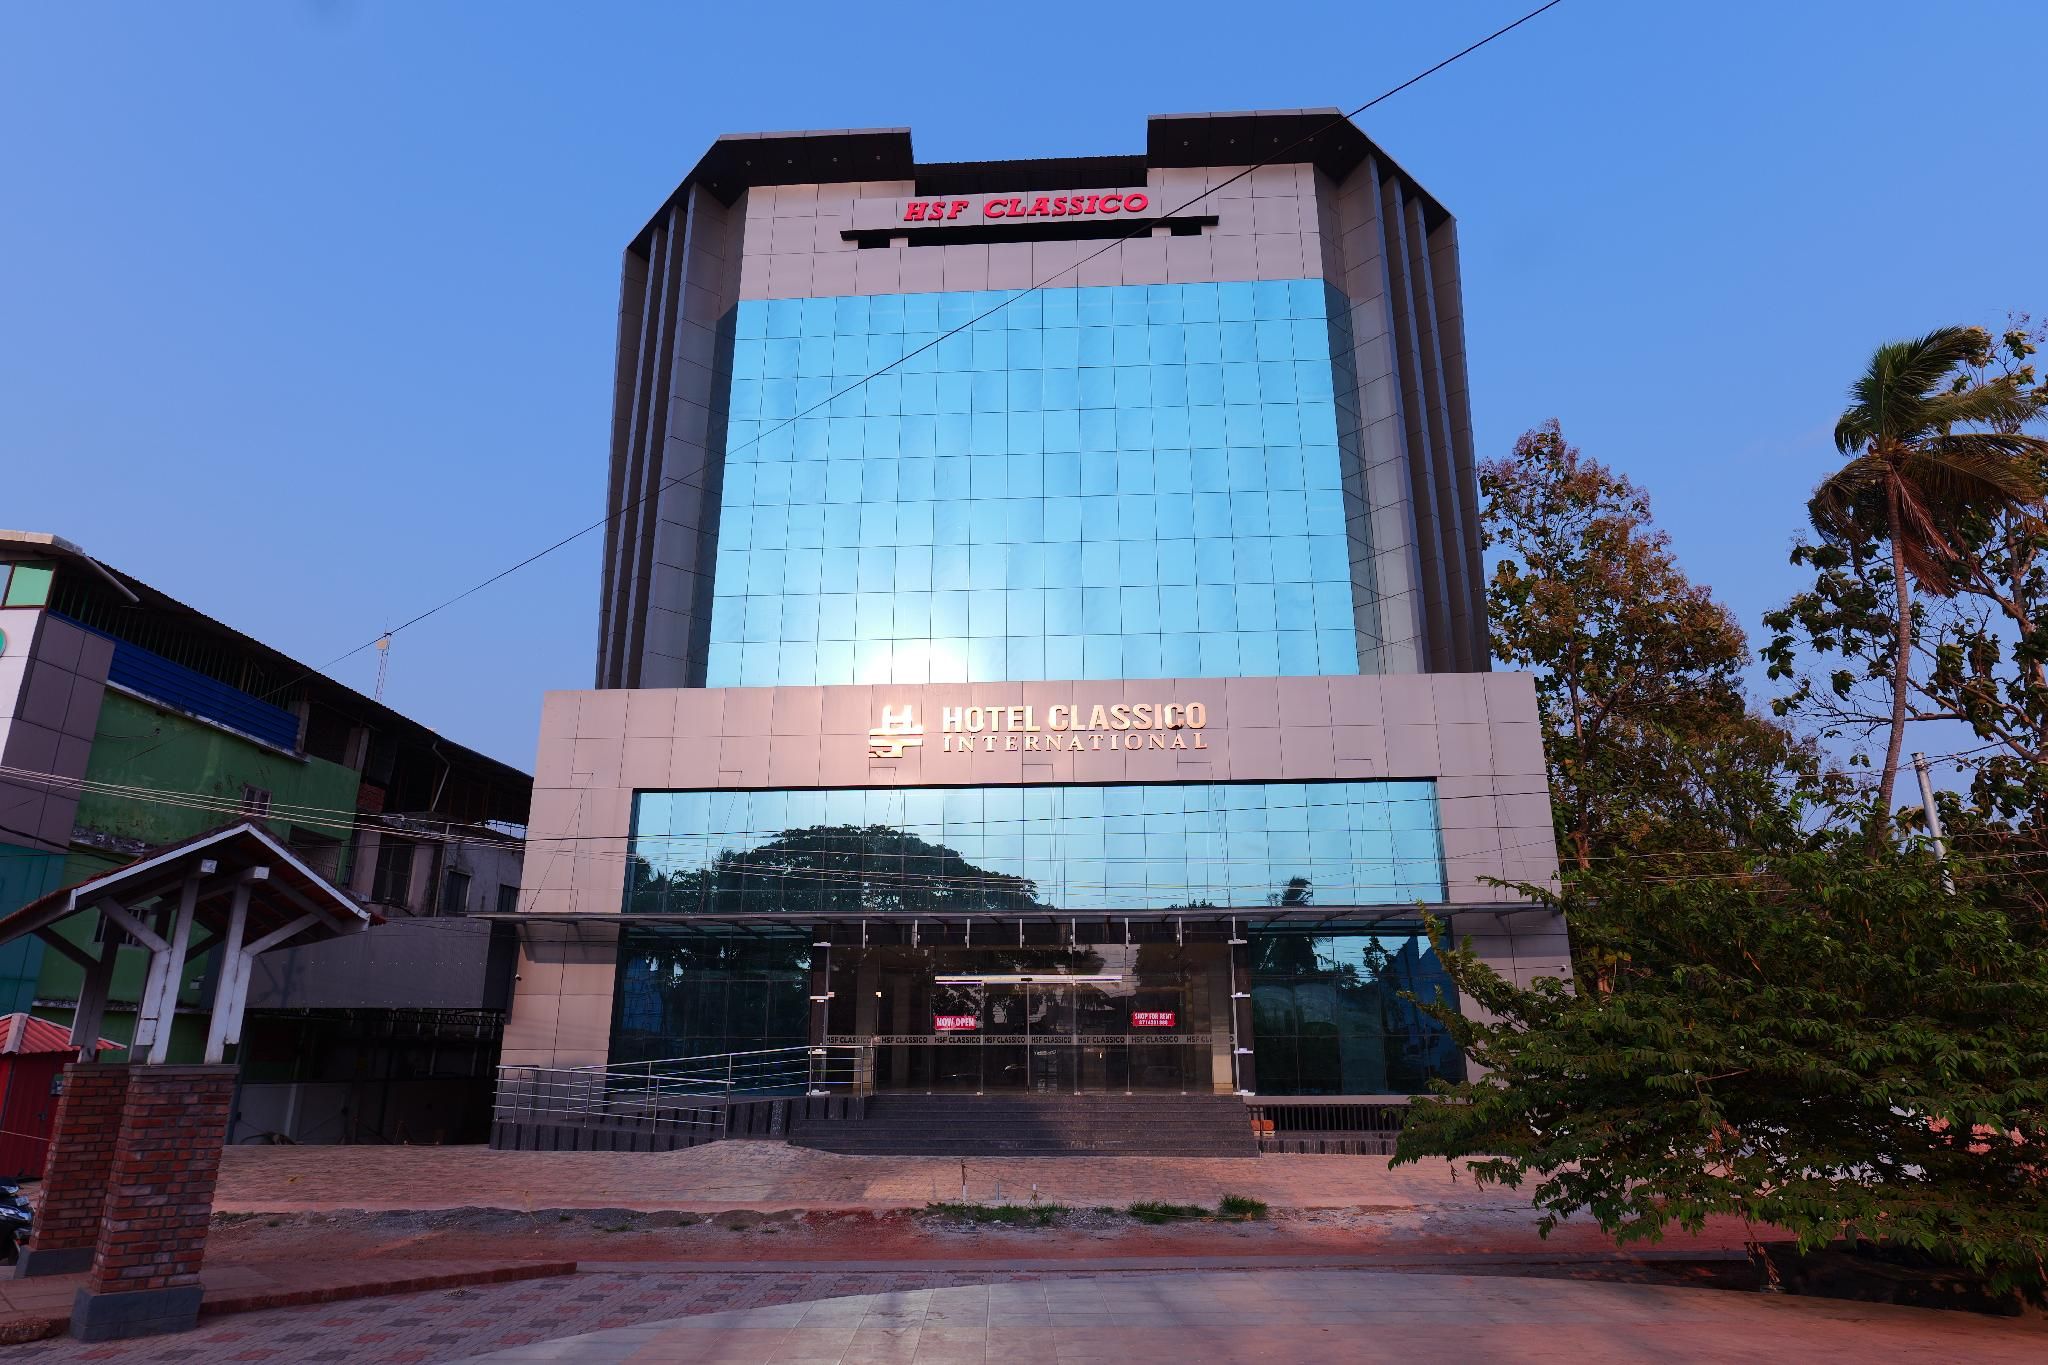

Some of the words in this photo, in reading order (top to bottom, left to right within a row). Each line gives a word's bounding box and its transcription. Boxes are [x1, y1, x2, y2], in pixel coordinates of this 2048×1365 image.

[903, 200, 969, 222] HSF
[983, 193, 1149, 219] CLASSICO
[942, 705, 1041, 733] HOTEL
[1048, 702, 1207, 731] CLASSICO
[942, 733, 1208, 753] INTERNATIONAL
[1149, 1012, 1159, 1020] FOR
[936, 1017, 954, 1027] NOW
[955, 1017, 975, 1027] OPEN
[896, 1036, 928, 1044] CLASSICO
[948, 1036, 980, 1044] CLASSICO
[997, 1036, 1026, 1044] CLASSICO
[1043, 1036, 1072, 1044] CLASSICO
[1092, 1036, 1125, 1044] CLASSICO
[1145, 1035, 1179, 1043] CLASSICO
